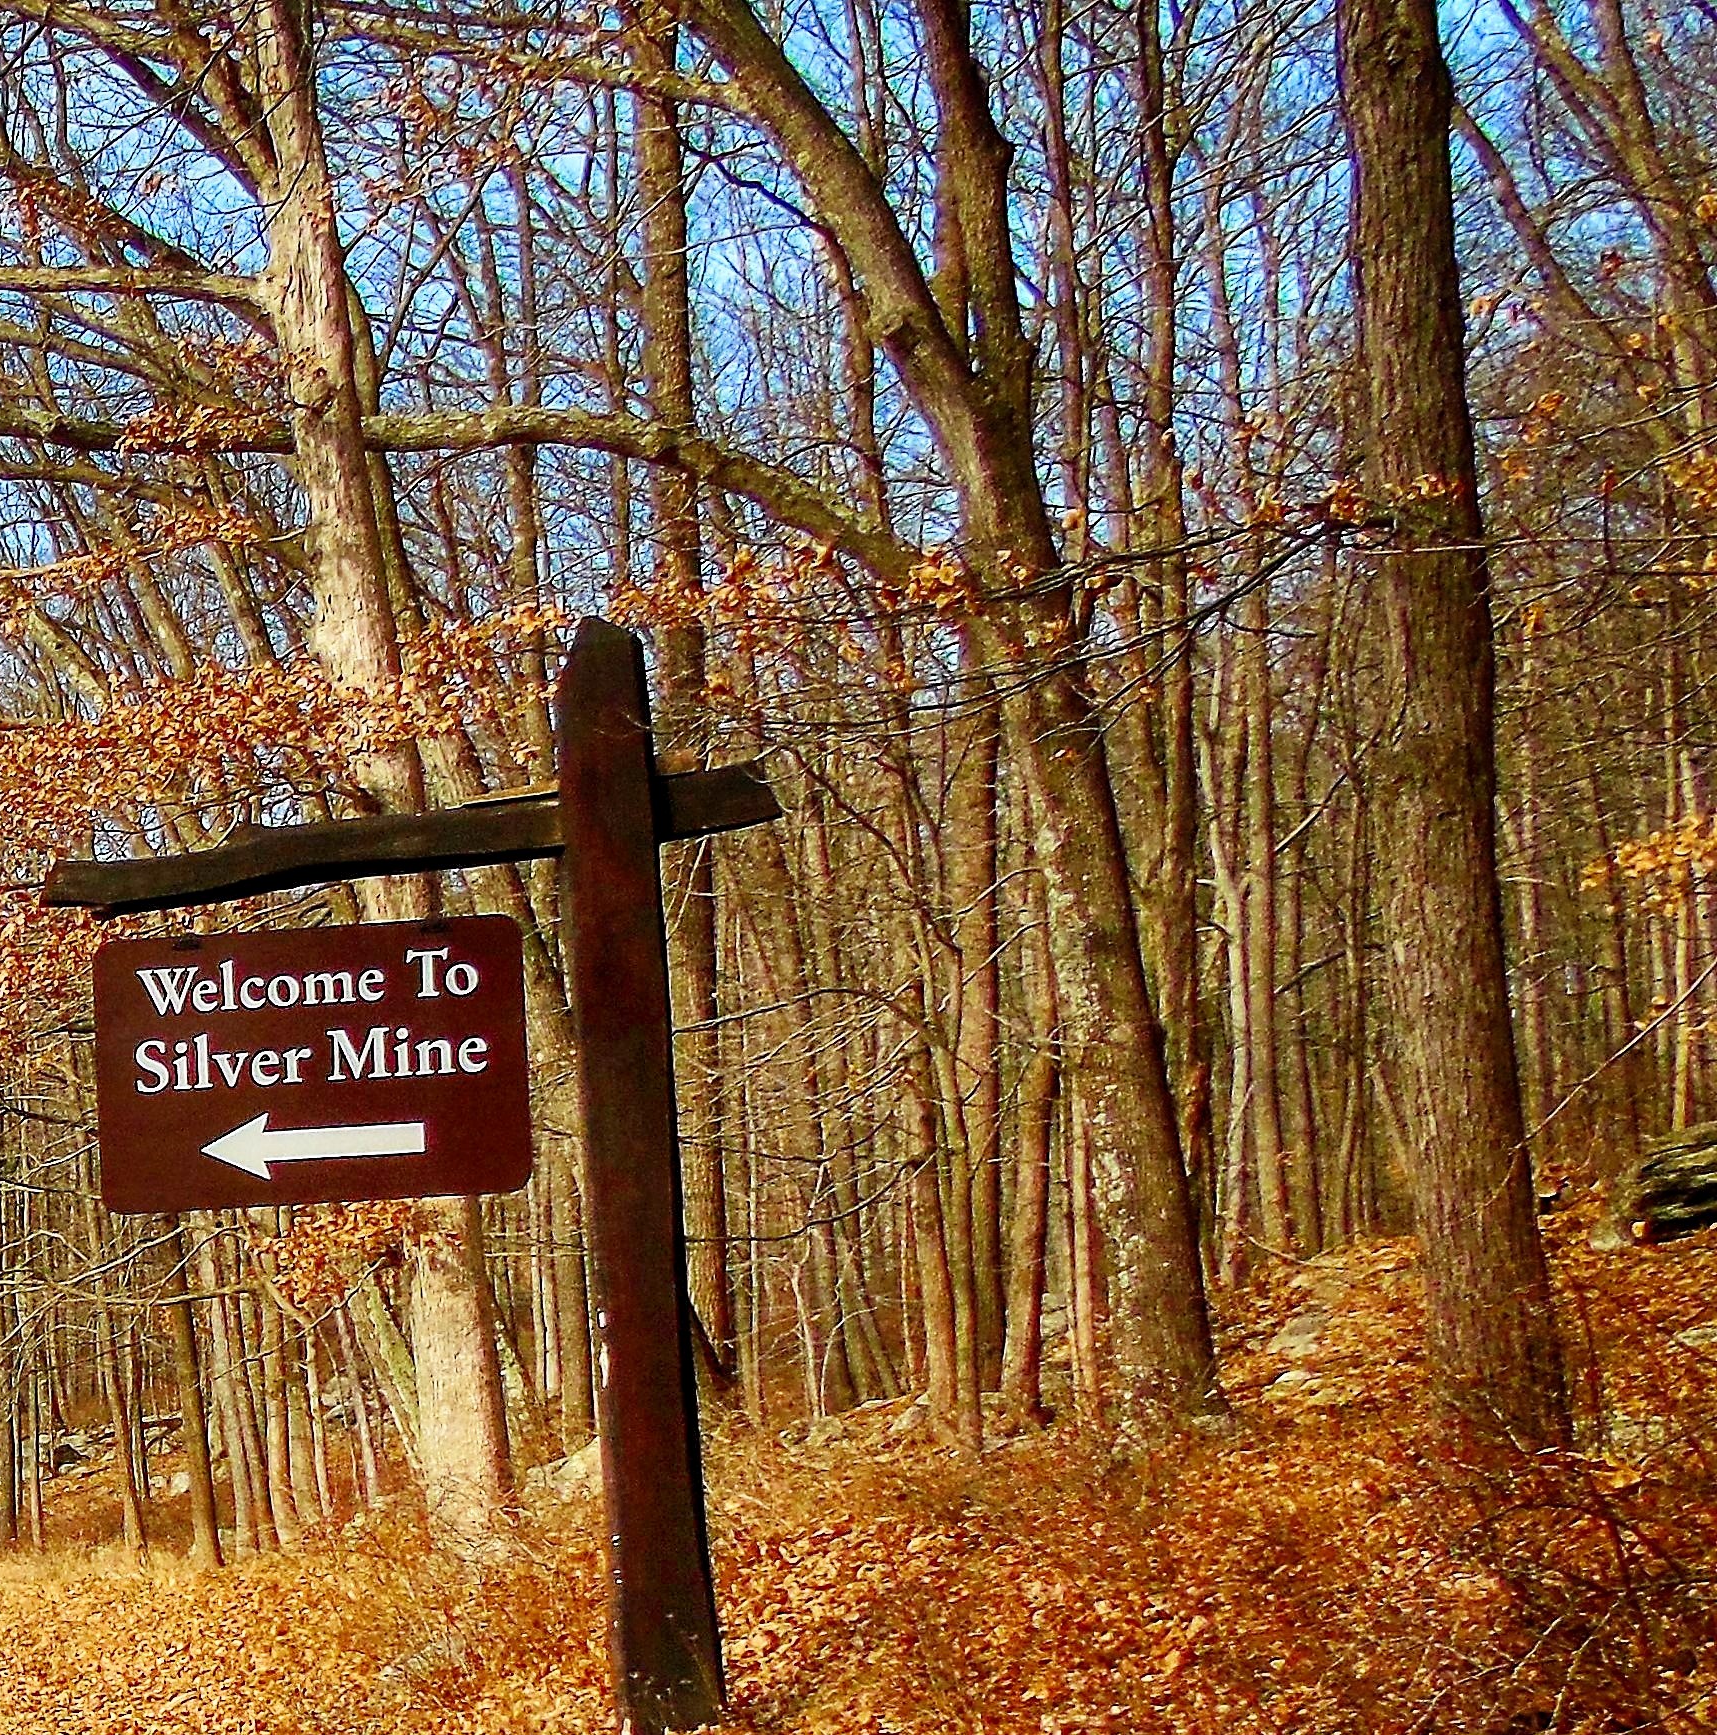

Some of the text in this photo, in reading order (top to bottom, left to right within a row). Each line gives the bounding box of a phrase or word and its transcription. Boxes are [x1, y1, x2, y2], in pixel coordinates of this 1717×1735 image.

[135, 947, 480, 1016] Welcome To
[135, 1026, 489, 1094] Silver Mine
